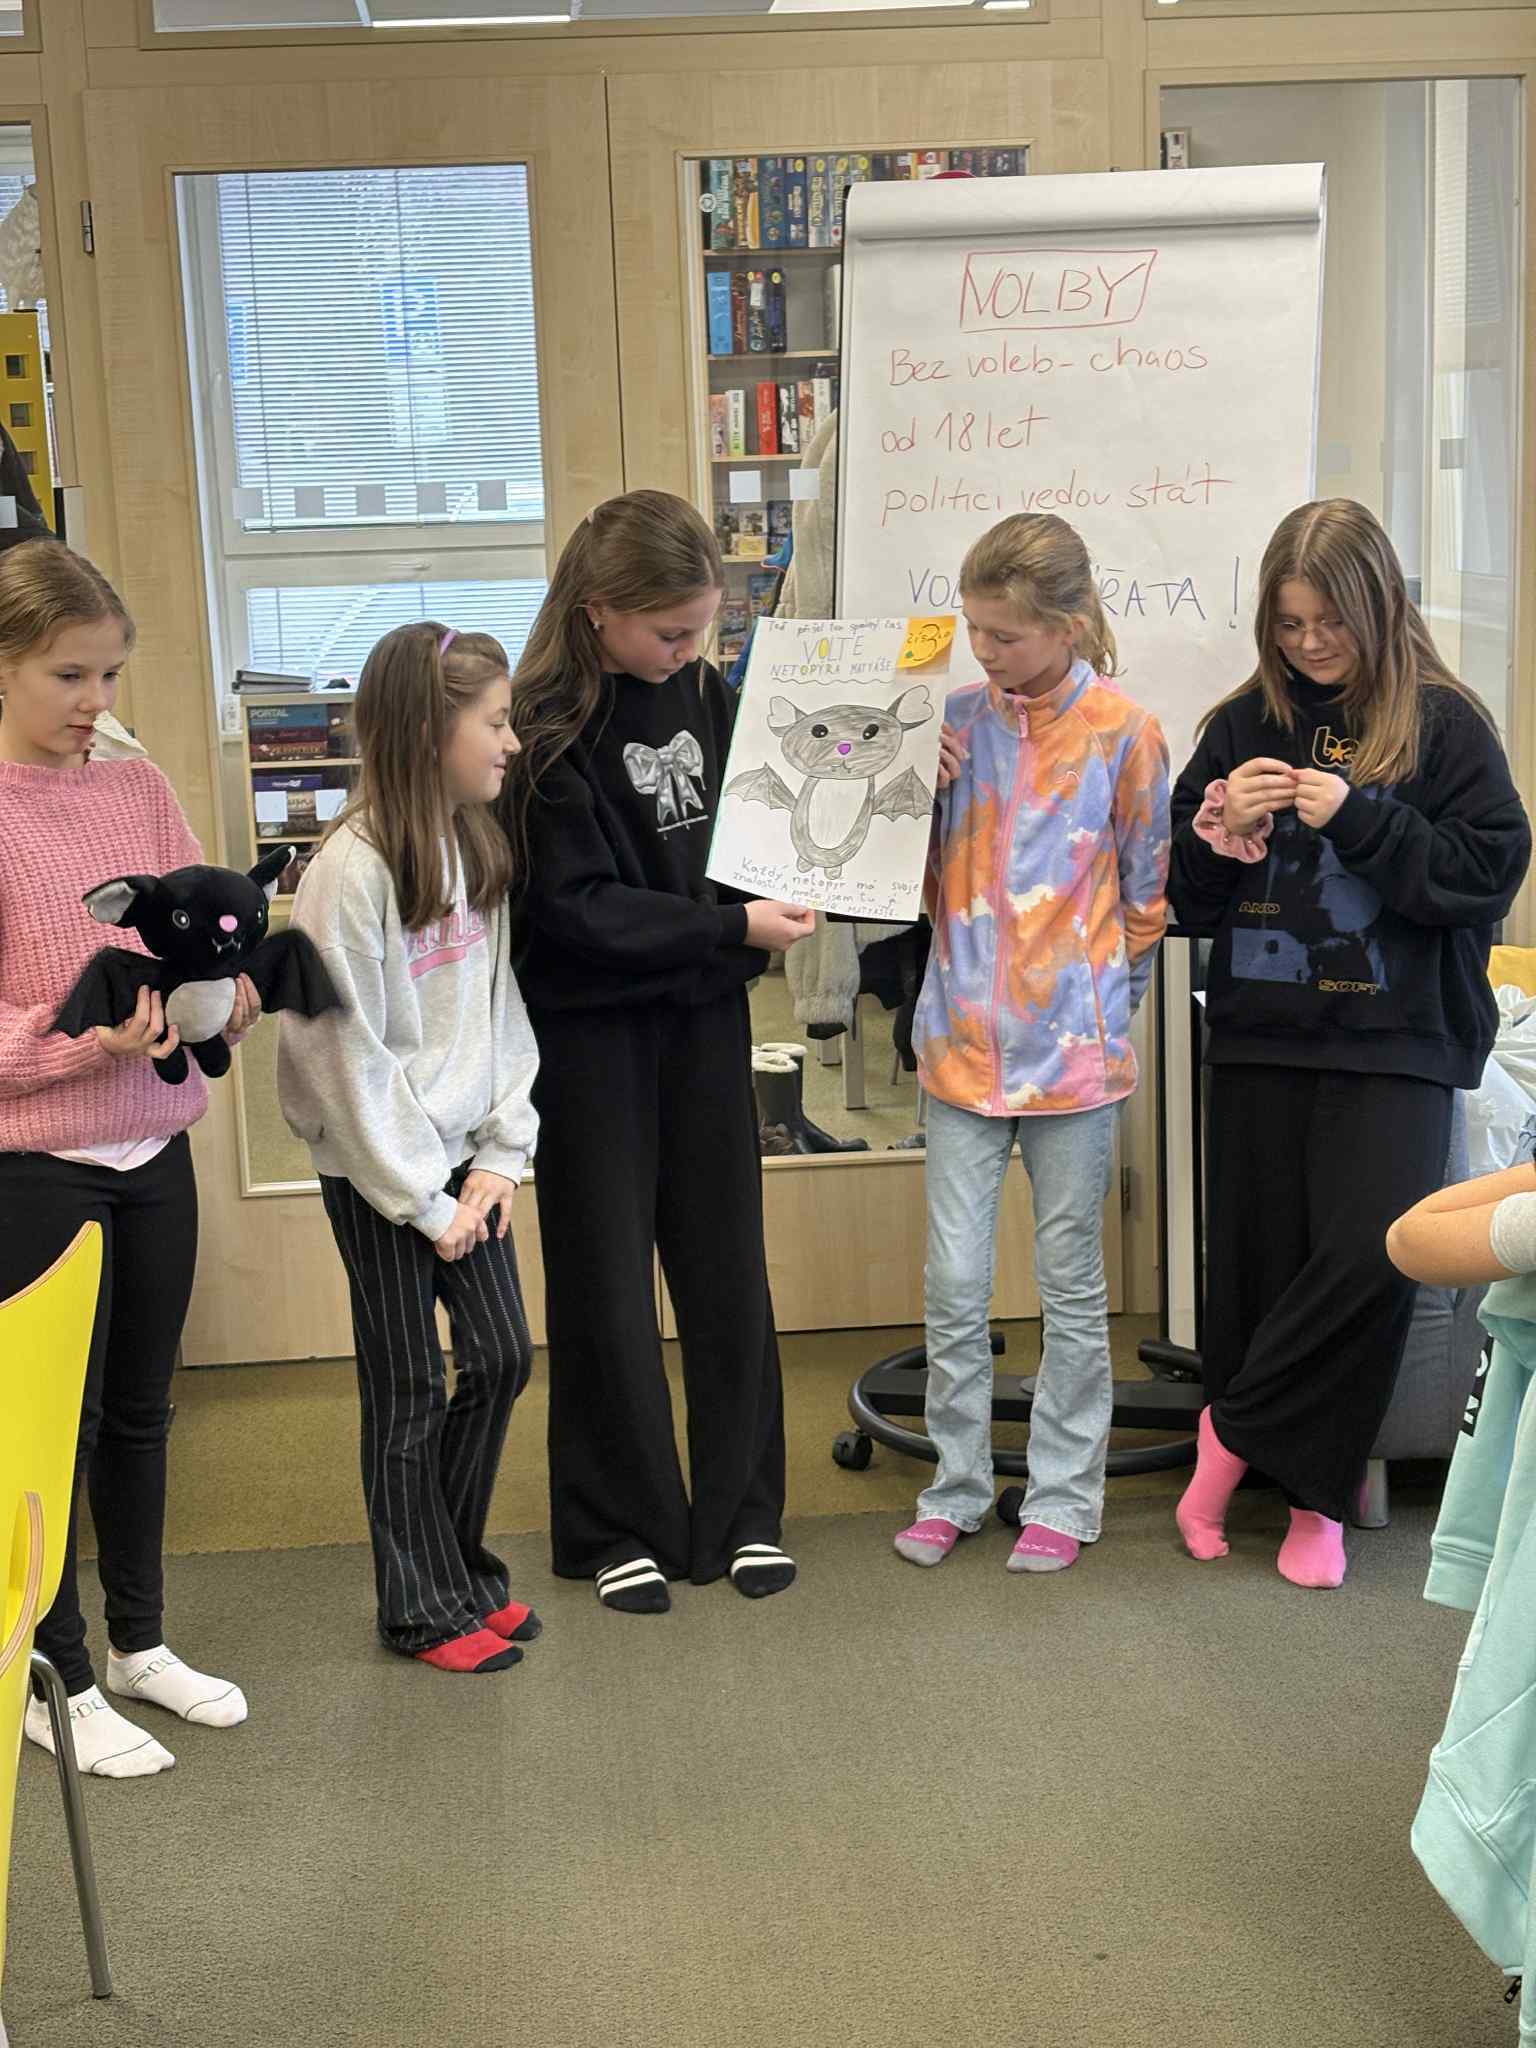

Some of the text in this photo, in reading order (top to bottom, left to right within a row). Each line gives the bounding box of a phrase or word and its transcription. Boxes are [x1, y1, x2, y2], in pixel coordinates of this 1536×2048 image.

[890, 349, 951, 386] Bez
[1090, 337, 1208, 373] chaos
[881, 405, 1049, 453] od 18 let
[881, 476, 1001, 527] politici
[1021, 469, 1112, 511] vedou
[803, 635, 864, 664] VOLTE
[1238, 902, 1281, 915] AND
[1318, 979, 1380, 995] SOFT
